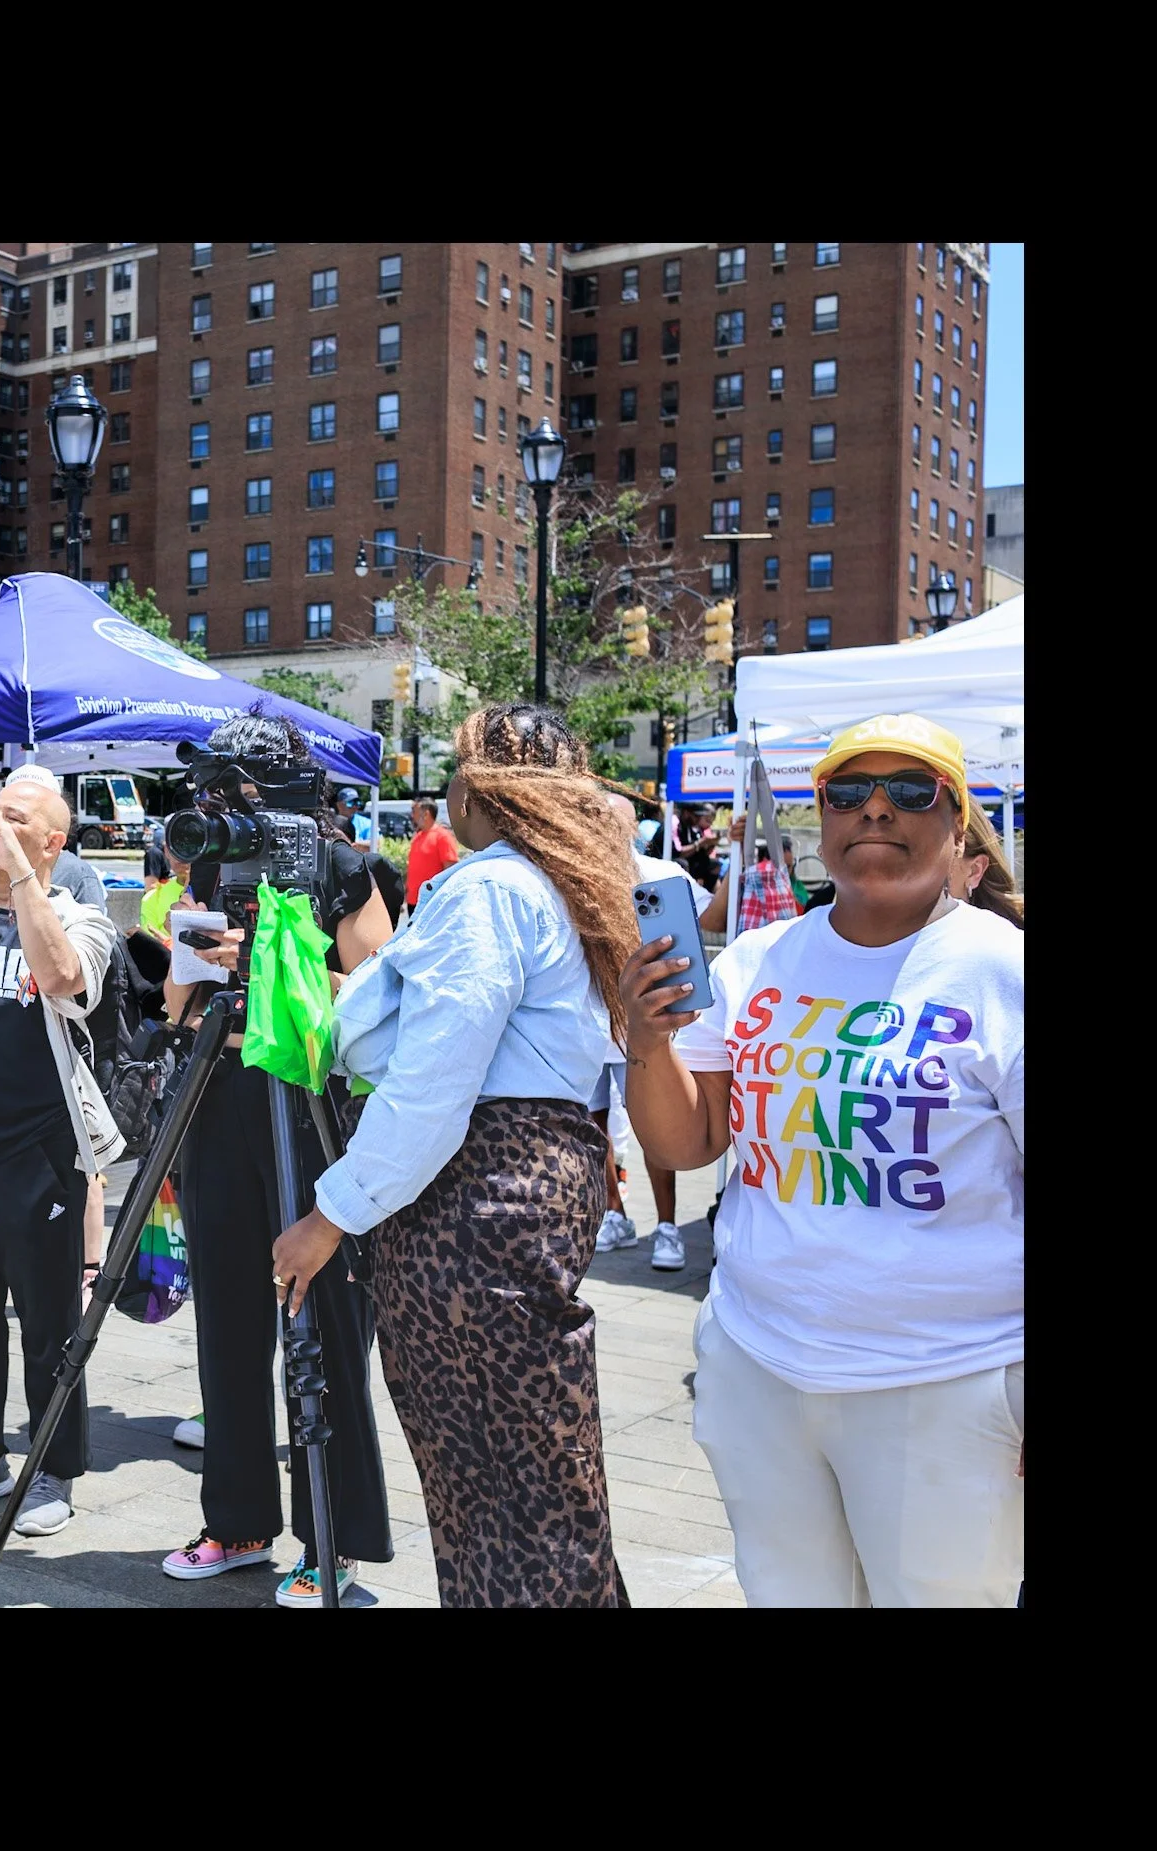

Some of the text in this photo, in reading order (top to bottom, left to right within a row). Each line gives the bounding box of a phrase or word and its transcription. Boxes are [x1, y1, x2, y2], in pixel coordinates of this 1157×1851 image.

[74, 695, 122, 715] Eviction
[123, 696, 184, 716] Prevention
[180, 700, 226, 723] Program
[687, 766, 707, 777] 851
[734, 987, 973, 1060] STOP
[725, 1039, 950, 1091] SHOOTING
[730, 1079, 950, 1154] START
